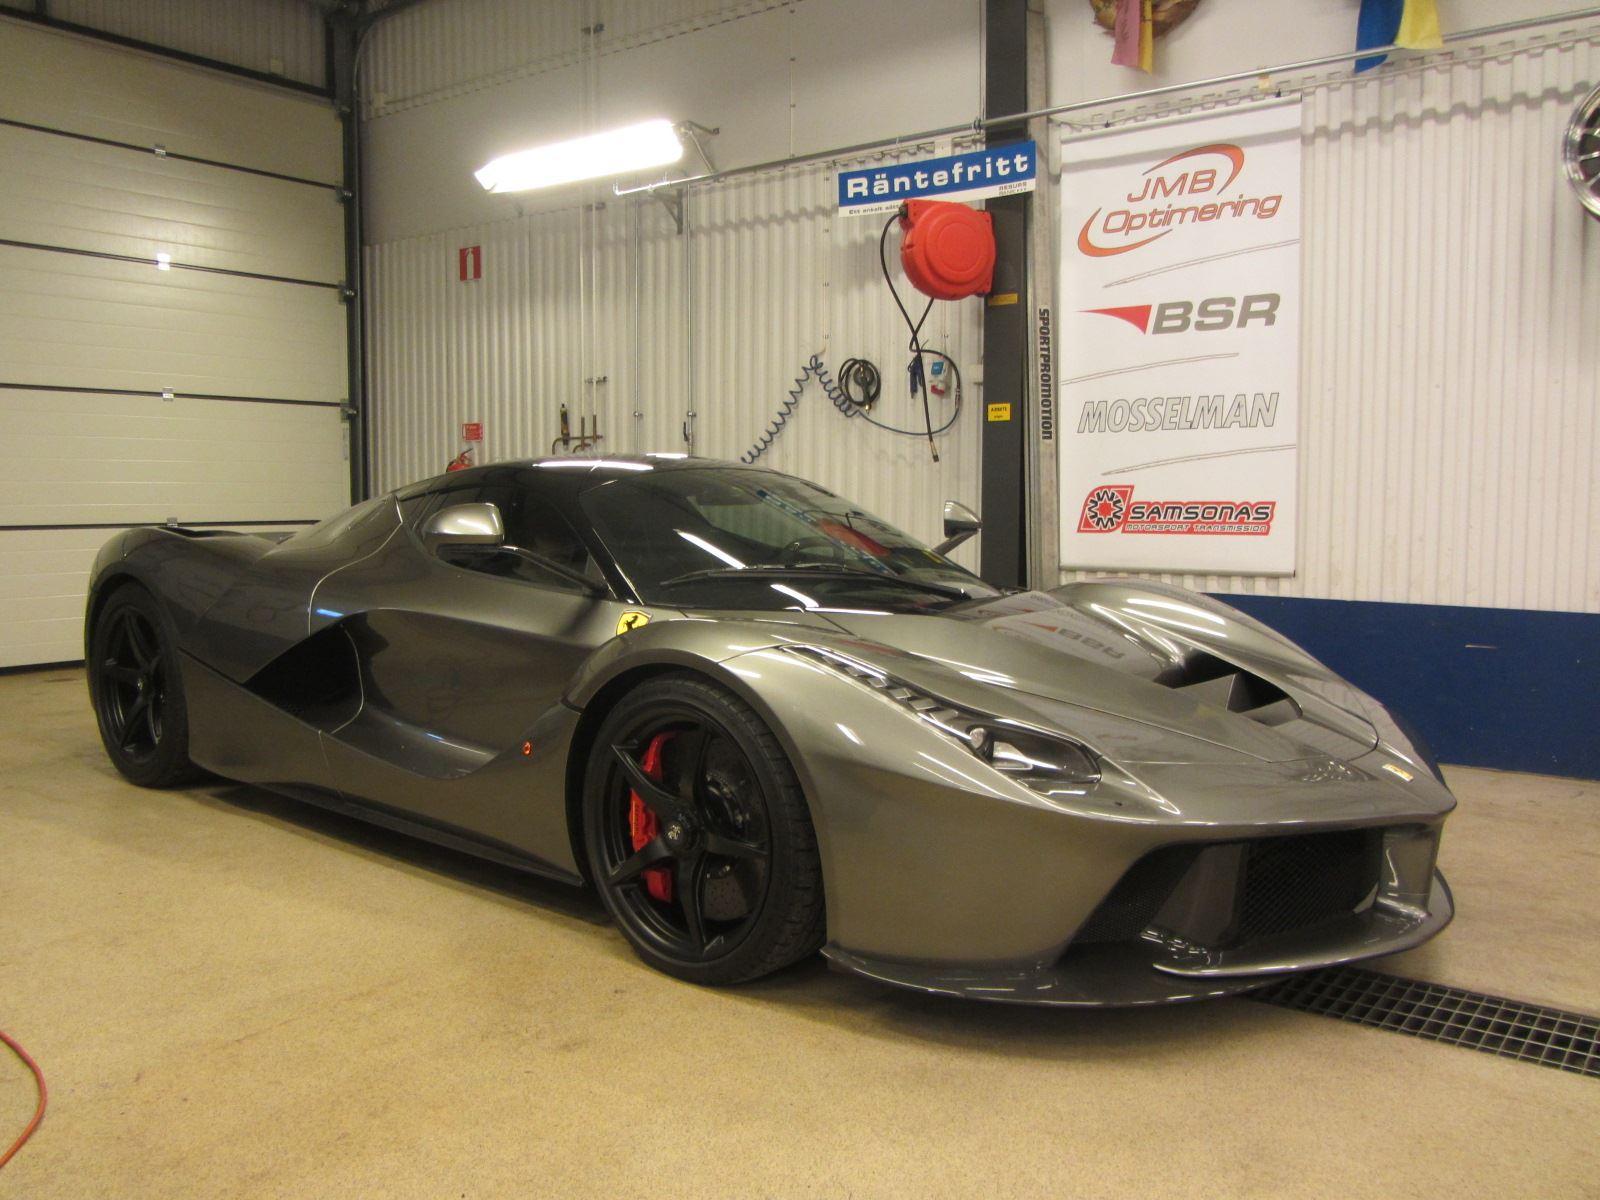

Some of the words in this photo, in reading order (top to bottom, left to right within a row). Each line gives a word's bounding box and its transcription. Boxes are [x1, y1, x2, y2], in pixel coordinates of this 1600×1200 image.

[847, 153, 1028, 199] Räntefritt
[1126, 168, 1217, 203] JMB
[1102, 193, 1283, 236] Optimering
[1152, 292, 1281, 335] BSR
[1039, 308, 1053, 440] SPORTPROMOTION
[1077, 392, 1280, 434] MOSSELMAN
[1125, 523, 1190, 531] MOTORSPORT
[1194, 523, 1268, 532] TRANSMISSION
[1129, 504, 1271, 521] SAMSONAS
